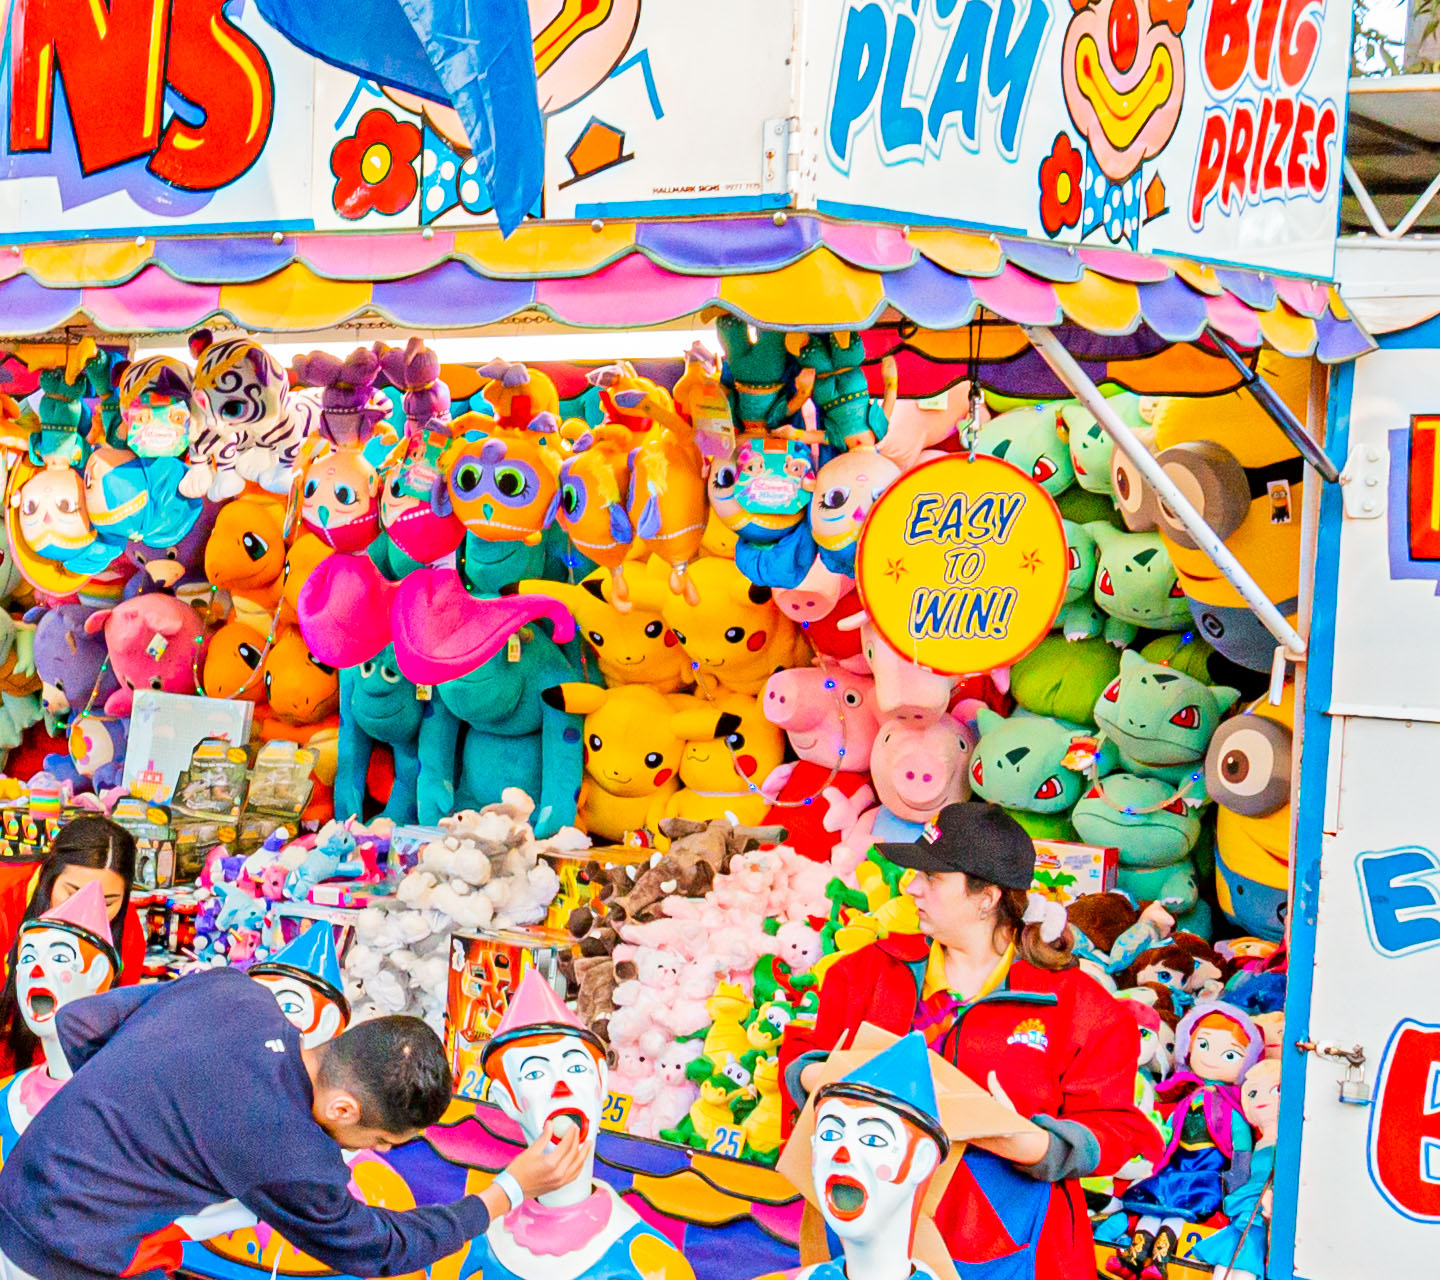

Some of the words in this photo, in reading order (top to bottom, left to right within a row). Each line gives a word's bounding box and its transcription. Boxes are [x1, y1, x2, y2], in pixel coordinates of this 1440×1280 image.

[1192, 97, 1335, 225] PRIZES
[908, 494, 1026, 544] EASY
[945, 548, 984, 584] TO
[909, 587, 1017, 640] WIN!
[461, 1069, 488, 1099] 24
[602, 1096, 626, 1123] 25
[711, 1126, 740, 1158] 25
